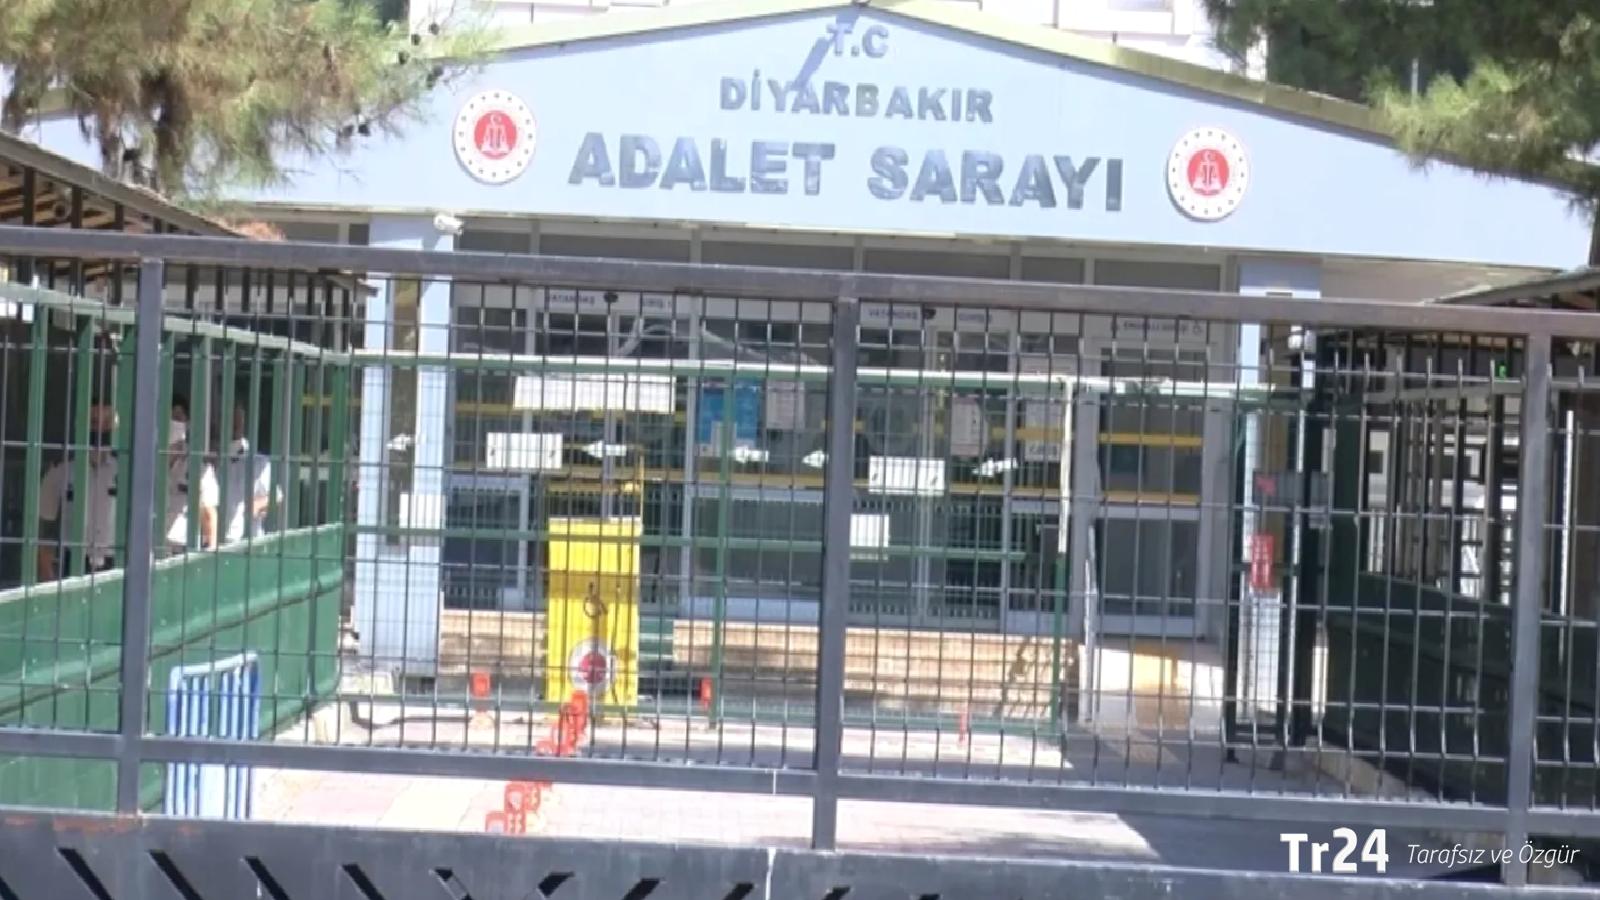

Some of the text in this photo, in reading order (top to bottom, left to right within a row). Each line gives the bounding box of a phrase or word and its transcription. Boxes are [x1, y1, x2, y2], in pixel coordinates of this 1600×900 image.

[827, 23, 889, 58] T.C
[720, 68, 994, 123] DİYARBAKIR
[568, 132, 1124, 212] ADALET SARAYI
